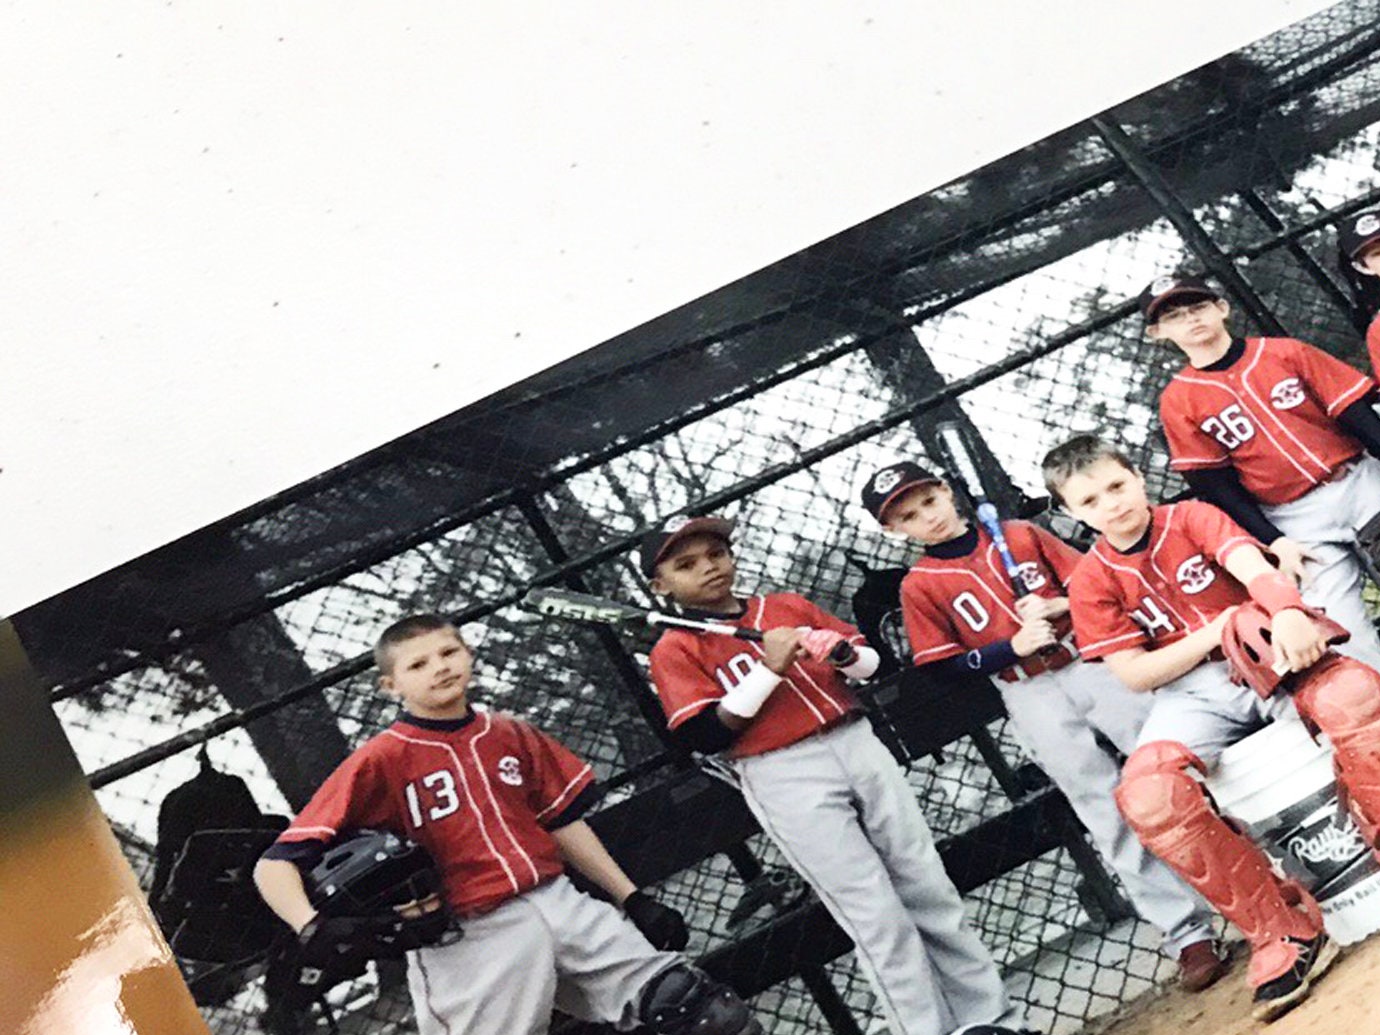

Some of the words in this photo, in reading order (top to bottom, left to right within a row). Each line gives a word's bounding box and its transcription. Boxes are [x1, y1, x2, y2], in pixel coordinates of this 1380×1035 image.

[1200, 403, 1254, 449] 26
[952, 590, 990, 633] 0
[405, 769, 460, 829] 13
